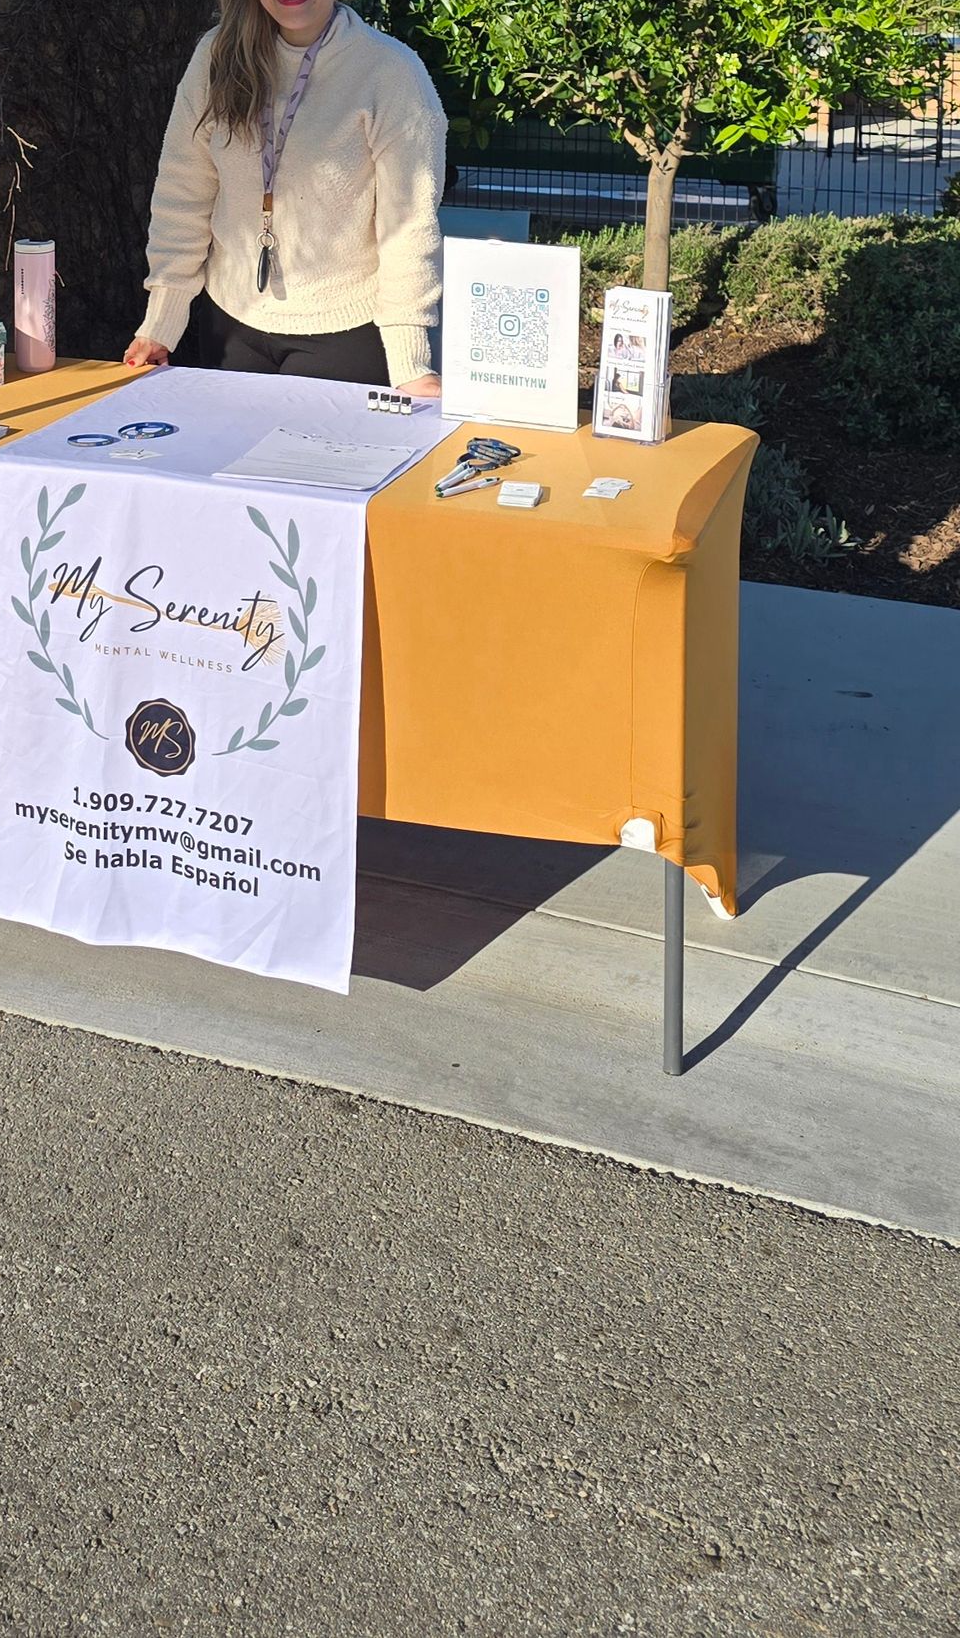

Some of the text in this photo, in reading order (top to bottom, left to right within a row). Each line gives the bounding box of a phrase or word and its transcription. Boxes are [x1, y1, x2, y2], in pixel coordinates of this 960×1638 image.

[470, 371, 547, 389] MYSERENITYMW
[50, 556, 285, 671] My Serenity
[94, 643, 233, 673] MENTAL WELLNESS
[138, 718, 183, 759] MS
[72, 786, 253, 836] 1.909.727.7207
[15, 802, 321, 882] myserenitymw@gmail.com
[64, 840, 259, 897] Se habla Español
